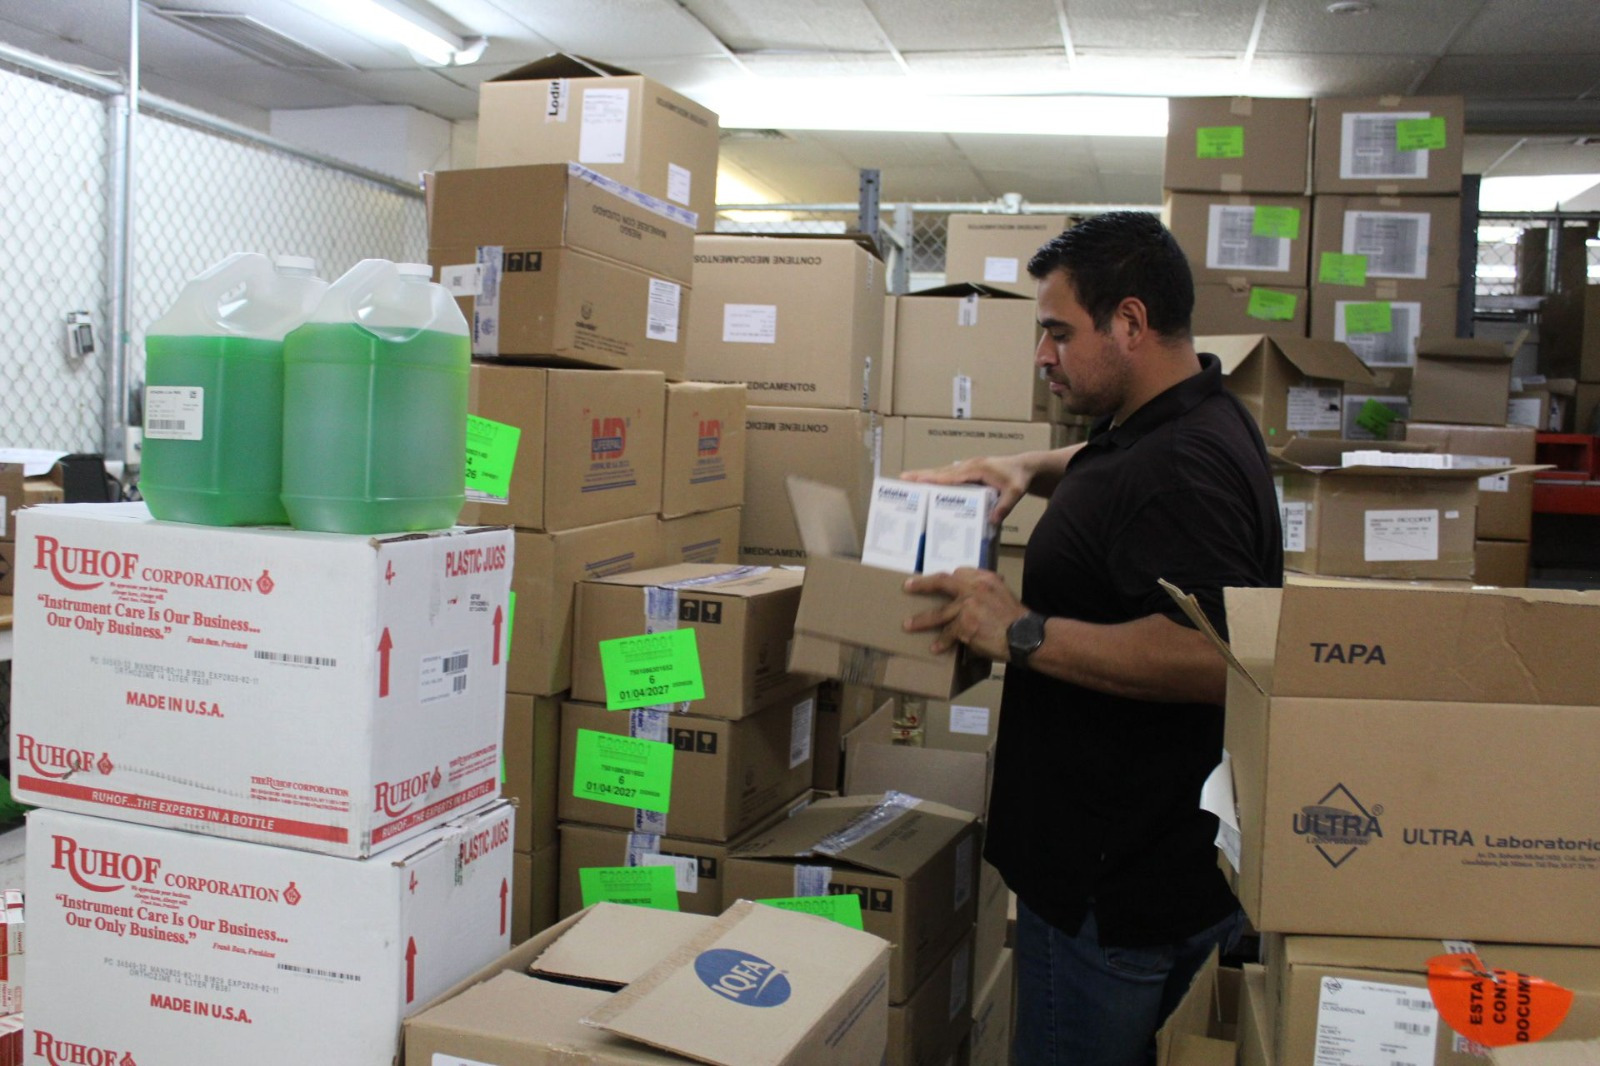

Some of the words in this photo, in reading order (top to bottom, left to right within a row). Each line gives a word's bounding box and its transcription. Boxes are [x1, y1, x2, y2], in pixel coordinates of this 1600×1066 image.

[694, 254, 770, 265] MEDICAMENTOS
[772, 255, 822, 265] CONTIENE
[777, 422, 828, 433] CONTIENE
[928, 429, 988, 438] MEDICAMENTOS
[988, 431, 1024, 440] CONTIENE
[33, 534, 139, 591] RUHOF
[142, 567, 253, 593] CORPORATION
[384, 560, 396, 585] 4
[445, 548, 482, 578] PLASTIC
[483, 544, 506, 572] JUGS
[37, 593, 111, 615] “Instrument
[115, 602, 145, 620] Care
[148, 606, 160, 621] Is
[163, 608, 190, 625] Our
[193, 611, 261, 634] Business...
[47, 611, 72, 629] Our
[74, 615, 104, 636] Only
[107, 618, 172, 640] Business.”
[1309, 642, 1387, 665] TAPA
[619, 684, 670, 701] 01/04/2027
[648, 675, 656, 685] 6
[126, 691, 166, 710] MADE
[168, 696, 182, 712] IN
[185, 698, 225, 718] U.S.A.
[16, 734, 95, 779] RUHOF
[293, 782, 349, 797] CORPORATION
[586, 780, 637, 799] 01/04/2027
[618, 775, 625, 785] 6
[373, 771, 431, 818] RUHOF
[159, 802, 205, 819] EXPERTS
[207, 809, 219, 821] IN
[222, 811, 230, 823] A
[232, 813, 275, 830] BOTTLE
[1292, 813, 1383, 838] ULTRA
[459, 829, 490, 866] PLASTIC
[490, 818, 509, 851] JUGS
[1402, 827, 1474, 847] ULTRA
[51, 834, 162, 893] RUHOF
[164, 872, 280, 903] CORPORATION
[408, 870, 419, 895] 4
[55, 893, 134, 918] “Instrument
[137, 906, 169, 924] Care
[172, 911, 184, 927] Is
[188, 914, 216, 932] Our
[218, 918, 289, 944] Business...
[65, 911, 92, 929] Our
[94, 916, 127, 937] Only
[130, 921, 197, 945] Business.”
[184, 977, 207, 990] LITER
[710, 959, 771, 999] IQFA
[150, 993, 191, 1014] MADE
[193, 1000, 209, 1017] IN
[211, 1003, 252, 1024] U.S.A.
[1470, 981, 1483, 1026] ESTA
[33, 1029, 118, 1066] RUHOF
